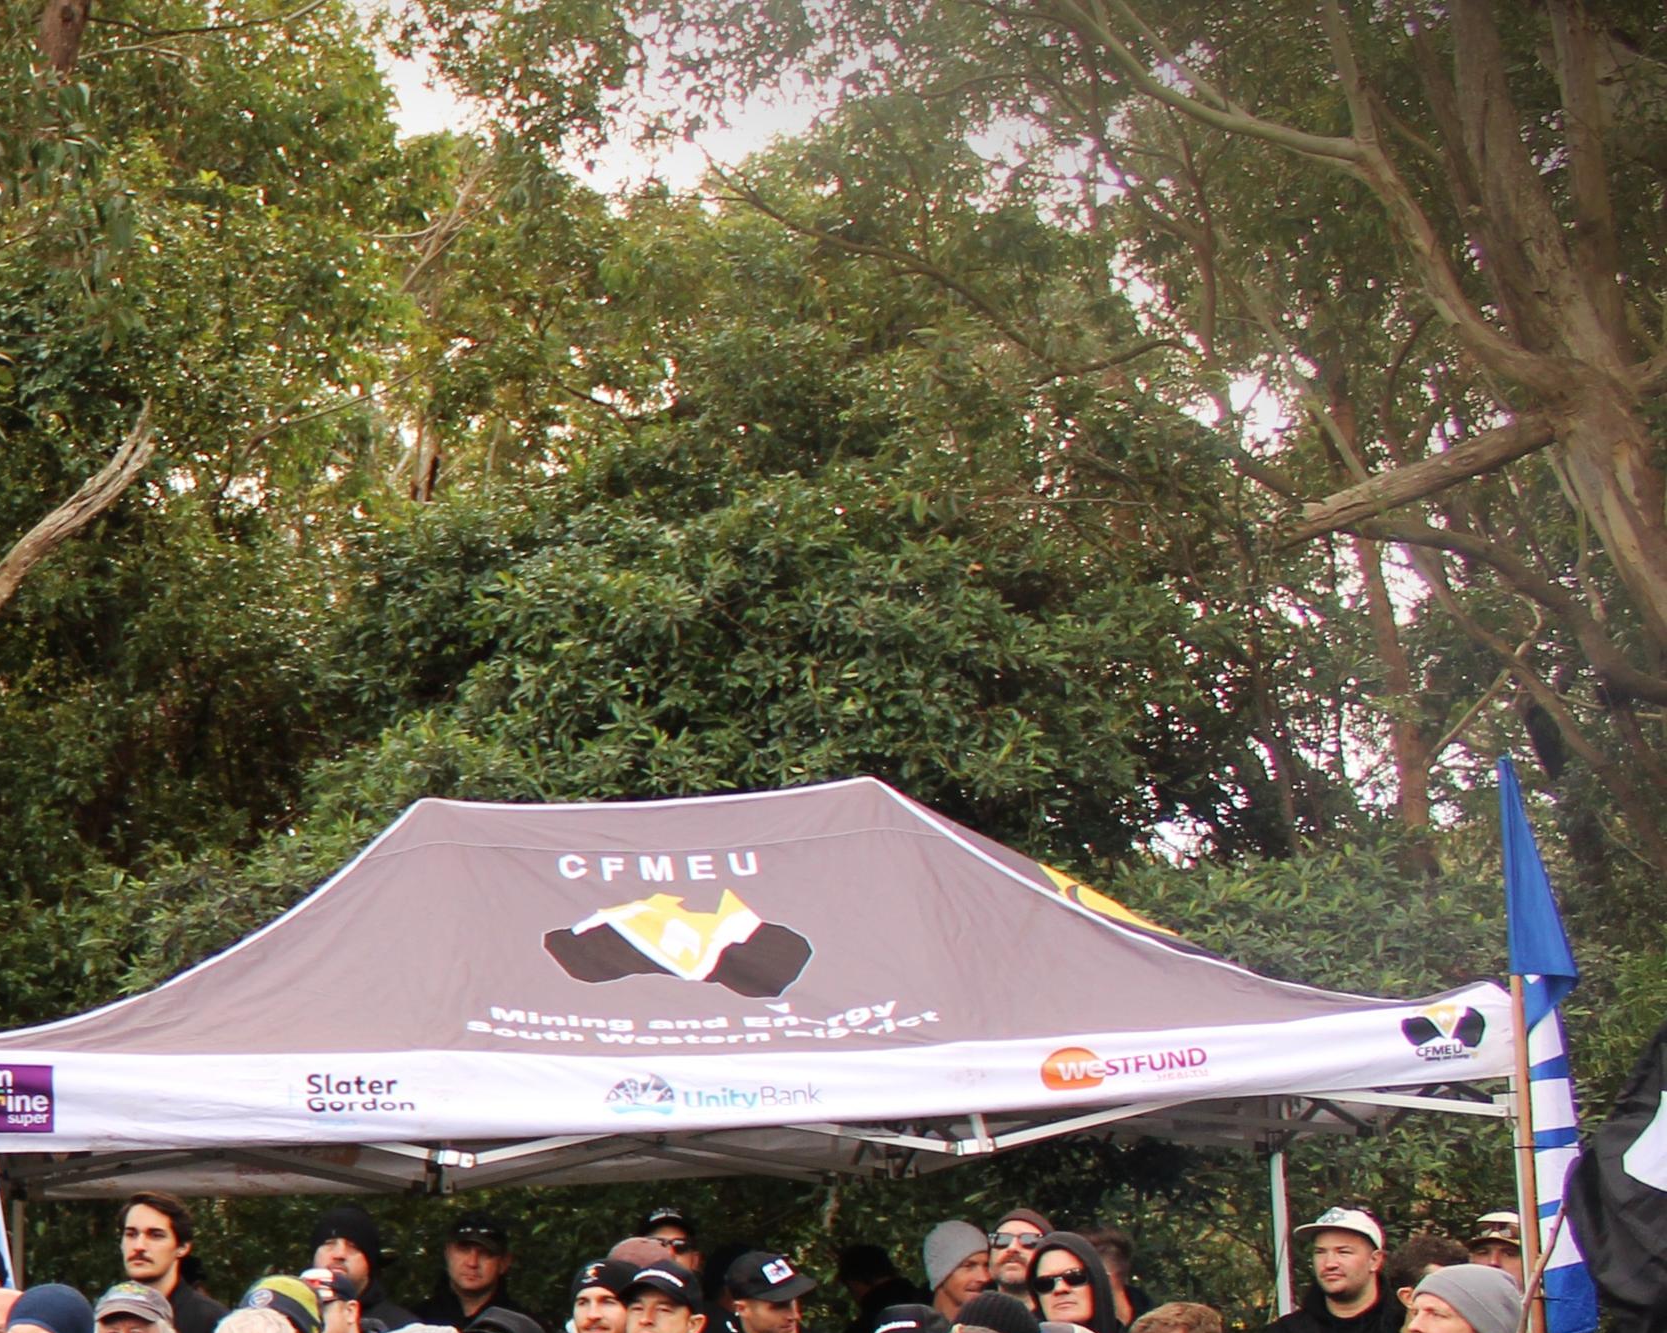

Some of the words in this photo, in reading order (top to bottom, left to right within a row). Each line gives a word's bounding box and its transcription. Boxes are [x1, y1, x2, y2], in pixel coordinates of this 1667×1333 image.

[558, 852, 760, 882] CFMEU
[490, 1006, 635, 1032] Mining
[647, 1016, 729, 1030] and
[466, 1020, 586, 1042] South
[595, 1031, 771, 1046] Western
[1415, 1044, 1464, 1058] CFMEU
[305, 1073, 399, 1096] Slater
[306, 1097, 416, 1113] Gordon
[7, 1112, 49, 1128] super
